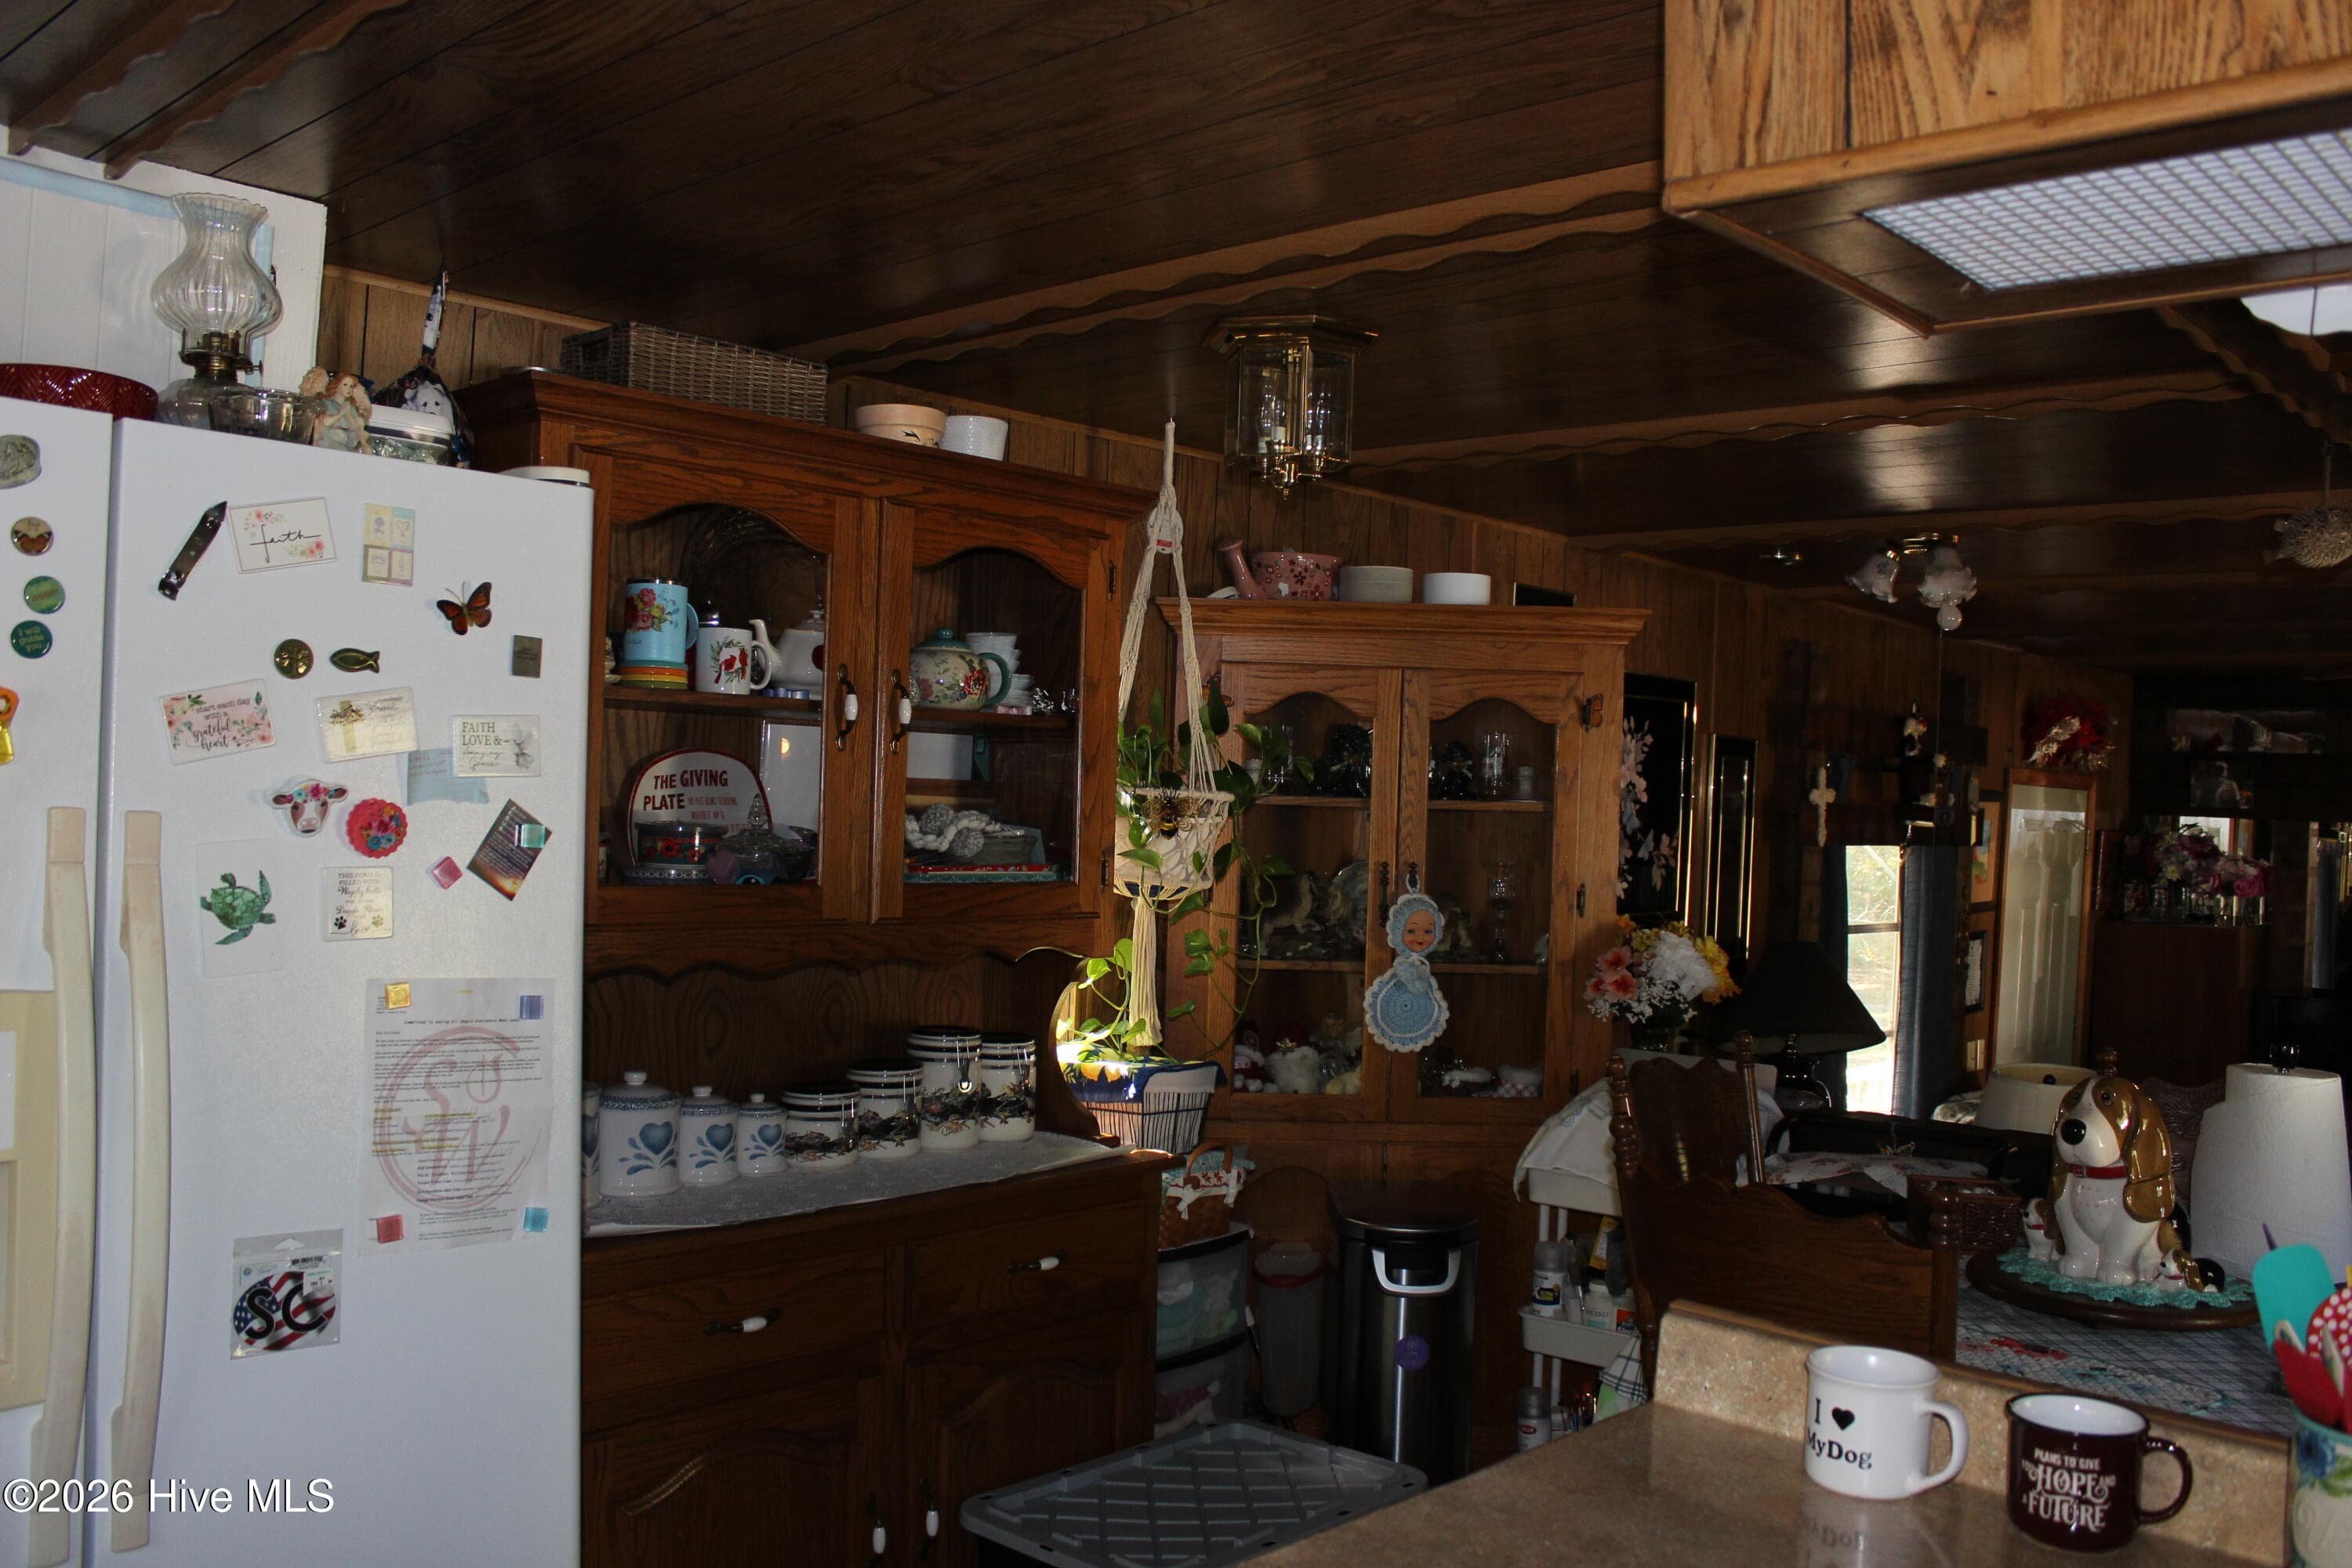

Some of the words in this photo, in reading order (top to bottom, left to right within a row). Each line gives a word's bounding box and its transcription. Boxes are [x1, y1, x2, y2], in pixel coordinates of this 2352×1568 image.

[250, 524, 321, 563] faith
[196, 705, 216, 713] start
[204, 712, 220, 720] with
[193, 717, 231, 742] grateful
[462, 722, 495, 733] FAITH
[201, 735, 229, 751] heart
[462, 735, 491, 746] LOVE
[494, 735, 503, 746] &
[654, 774, 677, 789] THE
[681, 769, 728, 787] GIVING
[644, 793, 685, 811] PLATE
[245, 1282, 328, 1340] SC
[1814, 1397, 1821, 1425] I
[2034, 1447, 2062, 1466] PLANS
[2063, 1455, 2077, 1468] TO
[2078, 1457, 2100, 1471] GIVE
[2030, 1464, 2108, 1504] HOPE
[2099, 1475, 2116, 1486] AND
[2028, 1490, 2111, 1533] FUTURE
